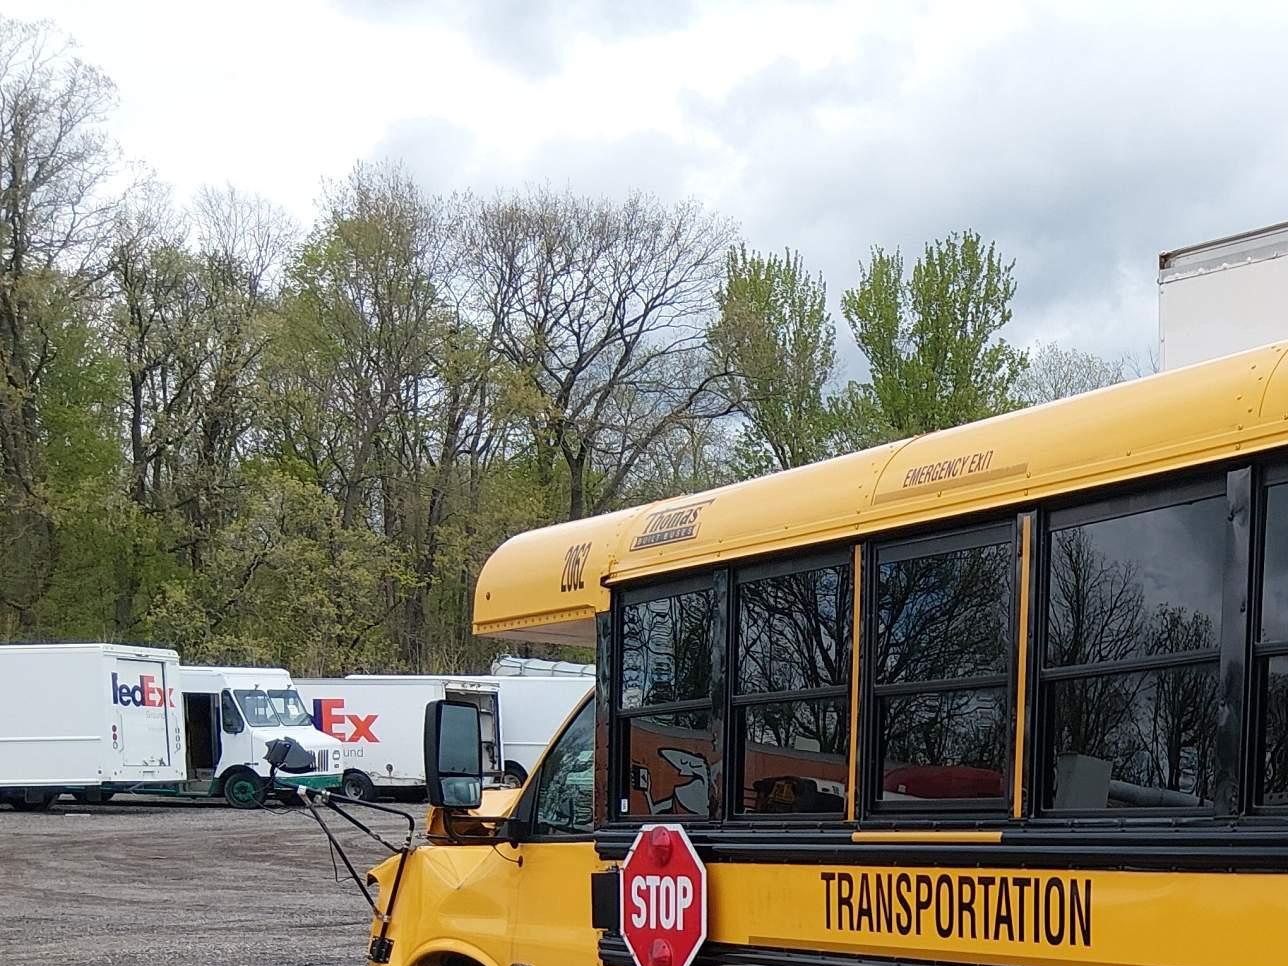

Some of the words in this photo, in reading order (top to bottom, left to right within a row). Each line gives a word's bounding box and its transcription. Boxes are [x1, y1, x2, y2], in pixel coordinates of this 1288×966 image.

[903, 455, 970, 488] EMERGENCY
[967, 450, 994, 474] EXIT
[643, 500, 713, 534] Thomas
[561, 541, 592, 592] 2062
[631, 876, 694, 931] STOP
[821, 872, 1092, 947] TRANSPORTATION
